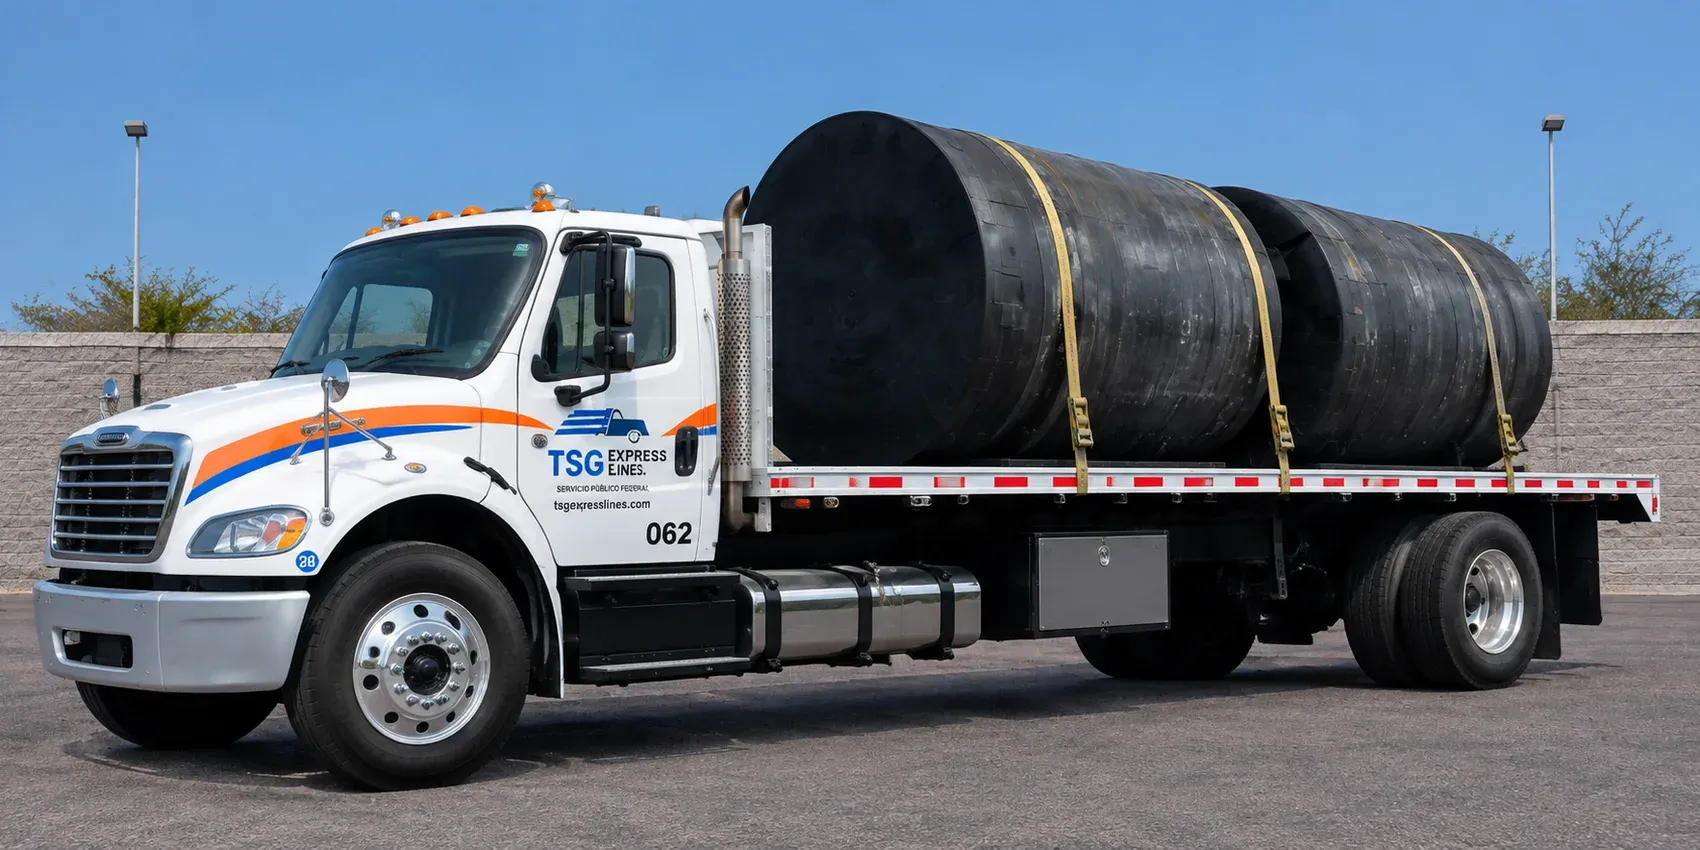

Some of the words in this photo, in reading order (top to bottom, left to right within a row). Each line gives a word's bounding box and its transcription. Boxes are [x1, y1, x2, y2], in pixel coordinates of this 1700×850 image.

[548, 449, 604, 477] TSG
[608, 450, 667, 462] EXPRESS
[556, 485, 589, 493] SERVICIO
[646, 522, 692, 545] 062
